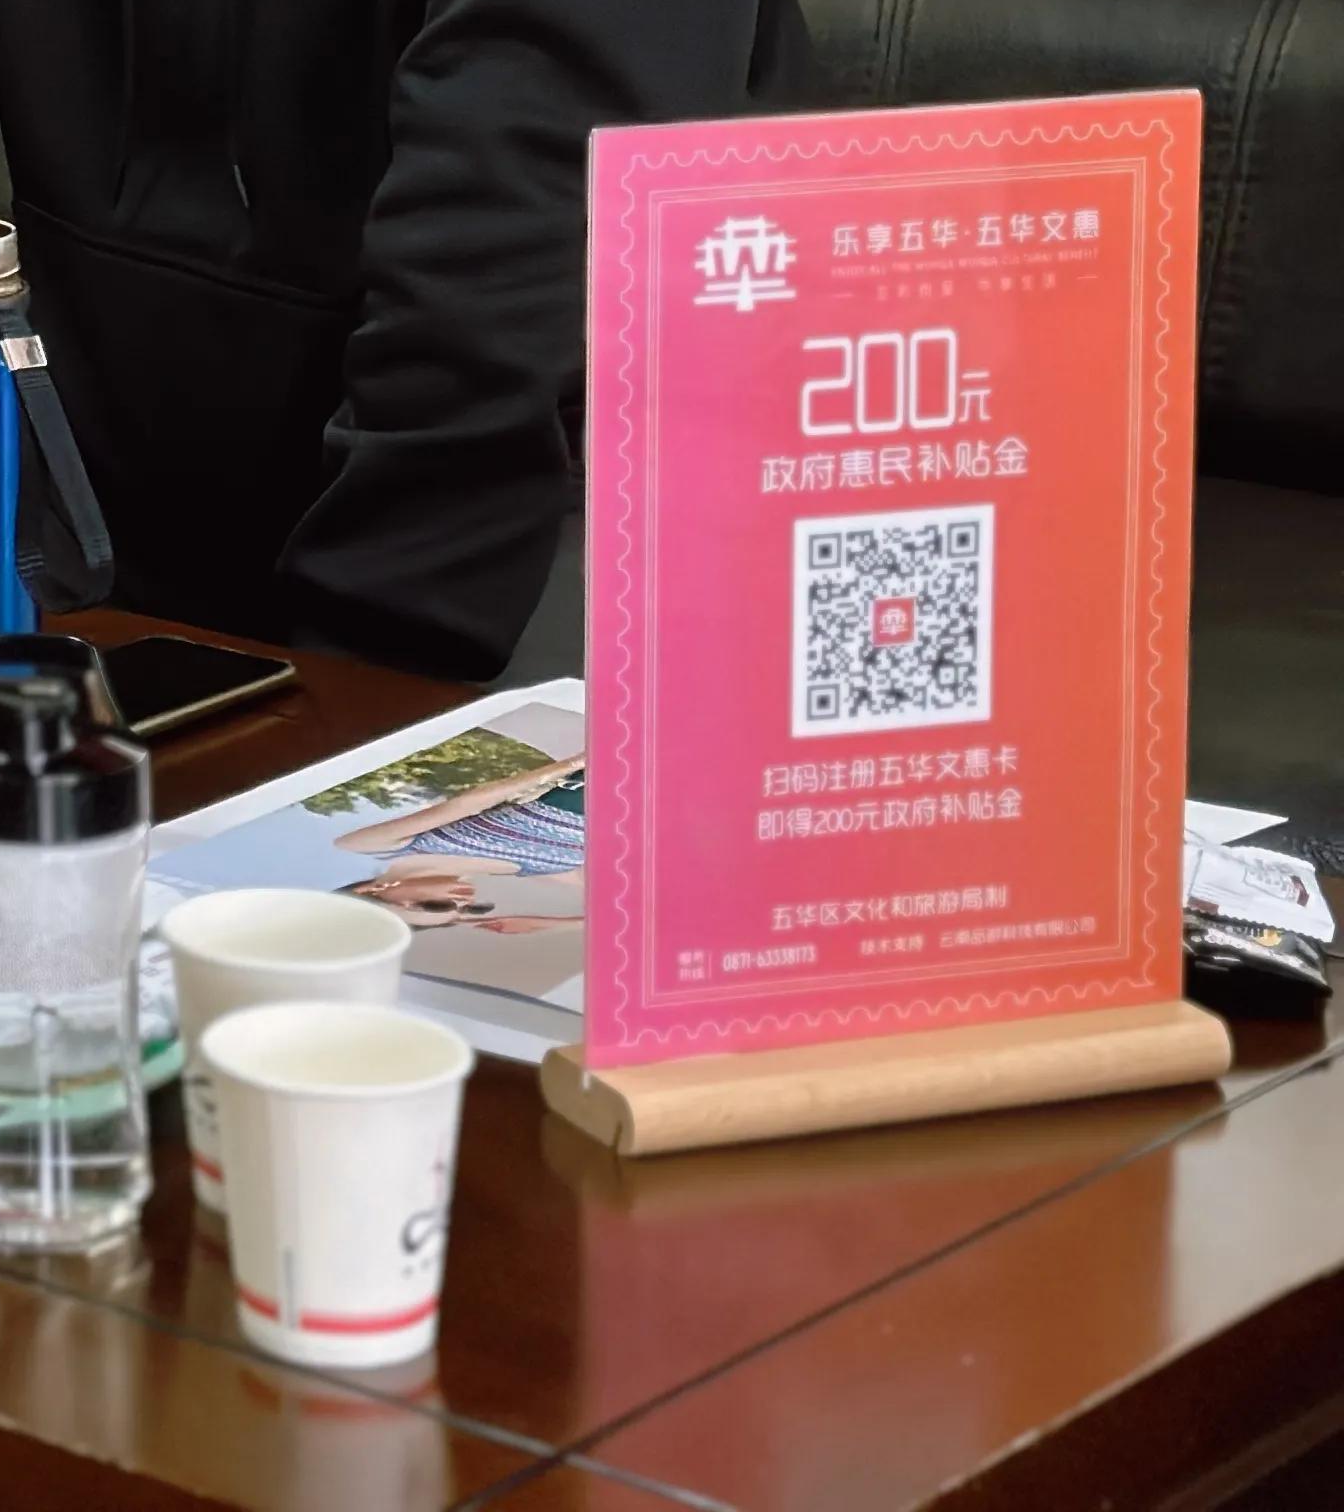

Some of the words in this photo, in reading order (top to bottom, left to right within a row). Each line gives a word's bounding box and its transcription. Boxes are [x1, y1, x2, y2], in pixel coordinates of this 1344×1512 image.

[832, 210, 1100, 256] 乐享五华·五华文惠
[801, 327, 992, 436] 200元
[761, 437, 1028, 493] 政府惠民补贴金
[762, 745, 1019, 798] 扫码注册五华文惠卡
[758, 787, 1023, 841] 即得200元政府补贴金
